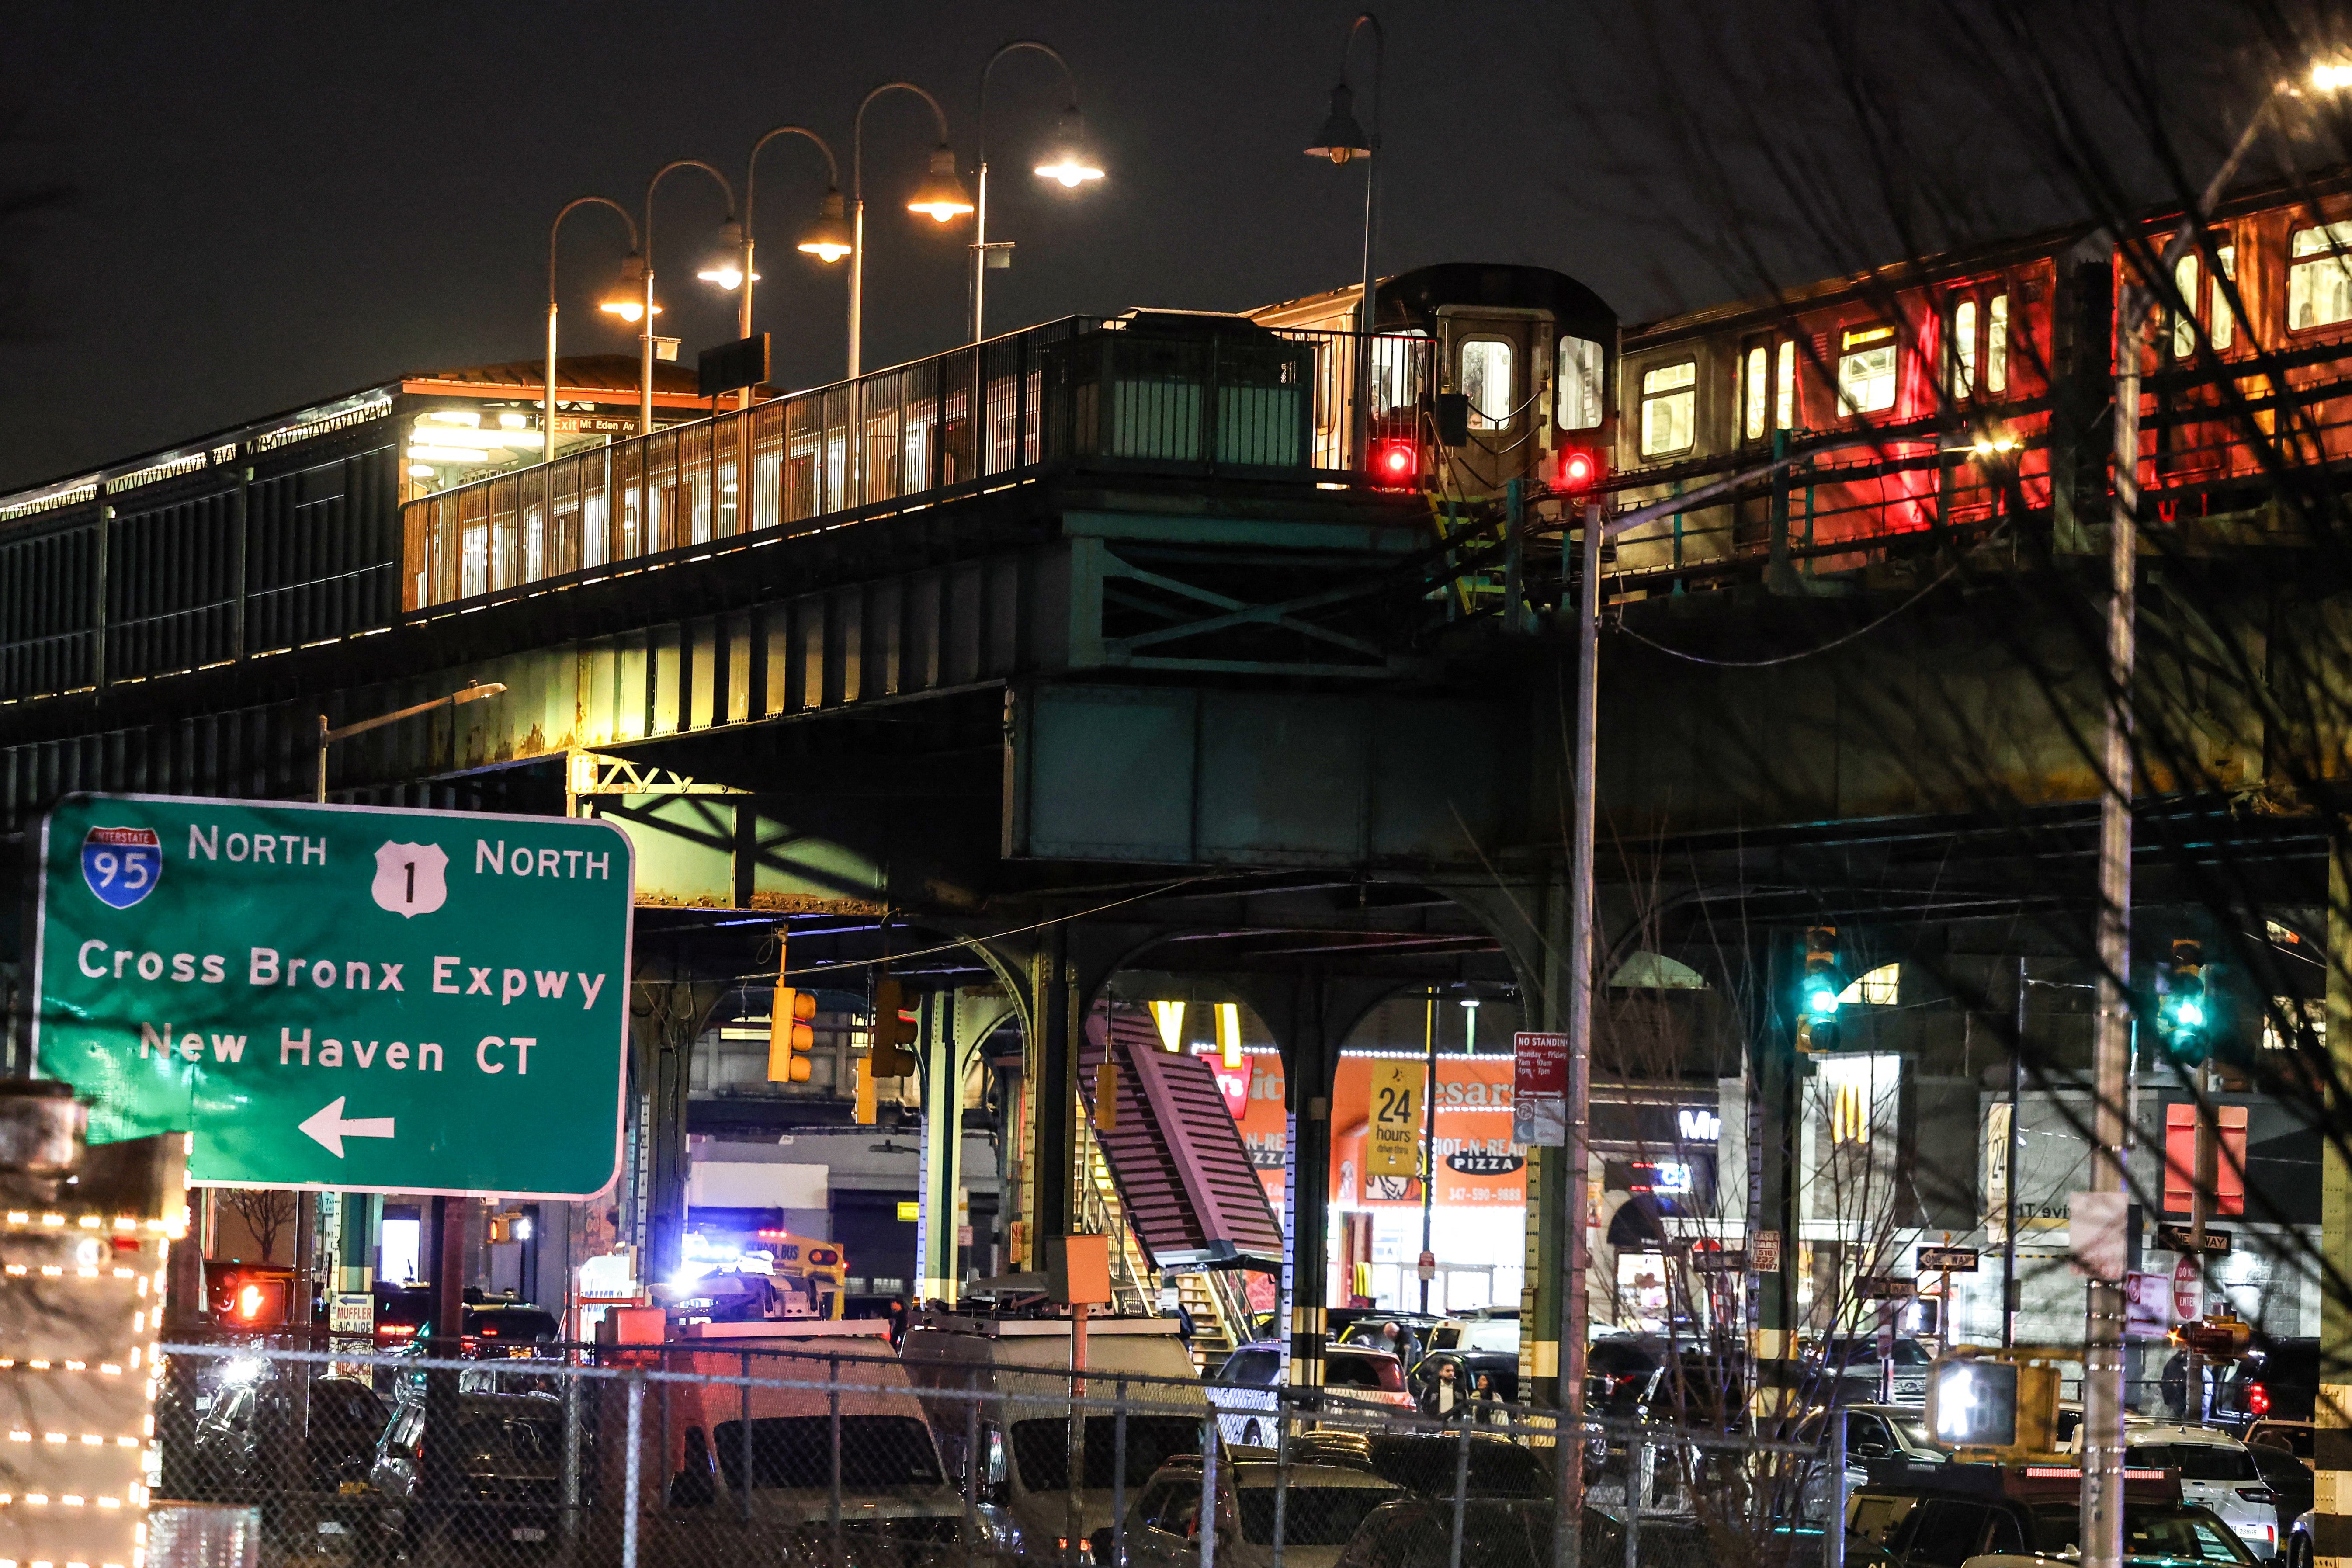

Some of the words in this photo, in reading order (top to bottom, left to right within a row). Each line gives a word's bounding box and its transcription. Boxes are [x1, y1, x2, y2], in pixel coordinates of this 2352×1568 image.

[554, 418, 577, 430] Exit
[580, 420, 592, 428] Mt
[596, 421, 618, 430] Eden
[623, 421, 635, 430] Av
[188, 824, 326, 865] NORTH
[476, 839, 609, 880] NORTH
[94, 852, 148, 889] 95
[405, 862, 415, 903] 1
[78, 939, 225, 983] Cross
[250, 947, 405, 992] Bronx
[433, 956, 606, 1010] Expwy
[140, 1022, 247, 1062] New
[280, 1027, 444, 1071] Haven
[476, 1036, 537, 1075] CT
[1519, 1037, 1530, 1046] NO
[1518, 1051, 1541, 1059] Monday
[1378, 1087, 1411, 1123] 24
[1377, 1124, 1411, 1143] hours
[1454, 1158, 1514, 1170] PIZZA
[1992, 1140, 2005, 1179] 24
[782, 1244, 799, 1259] BUS
[2179, 1267, 2187, 1277] DO
[337, 1307, 371, 1319] MUFFLER
